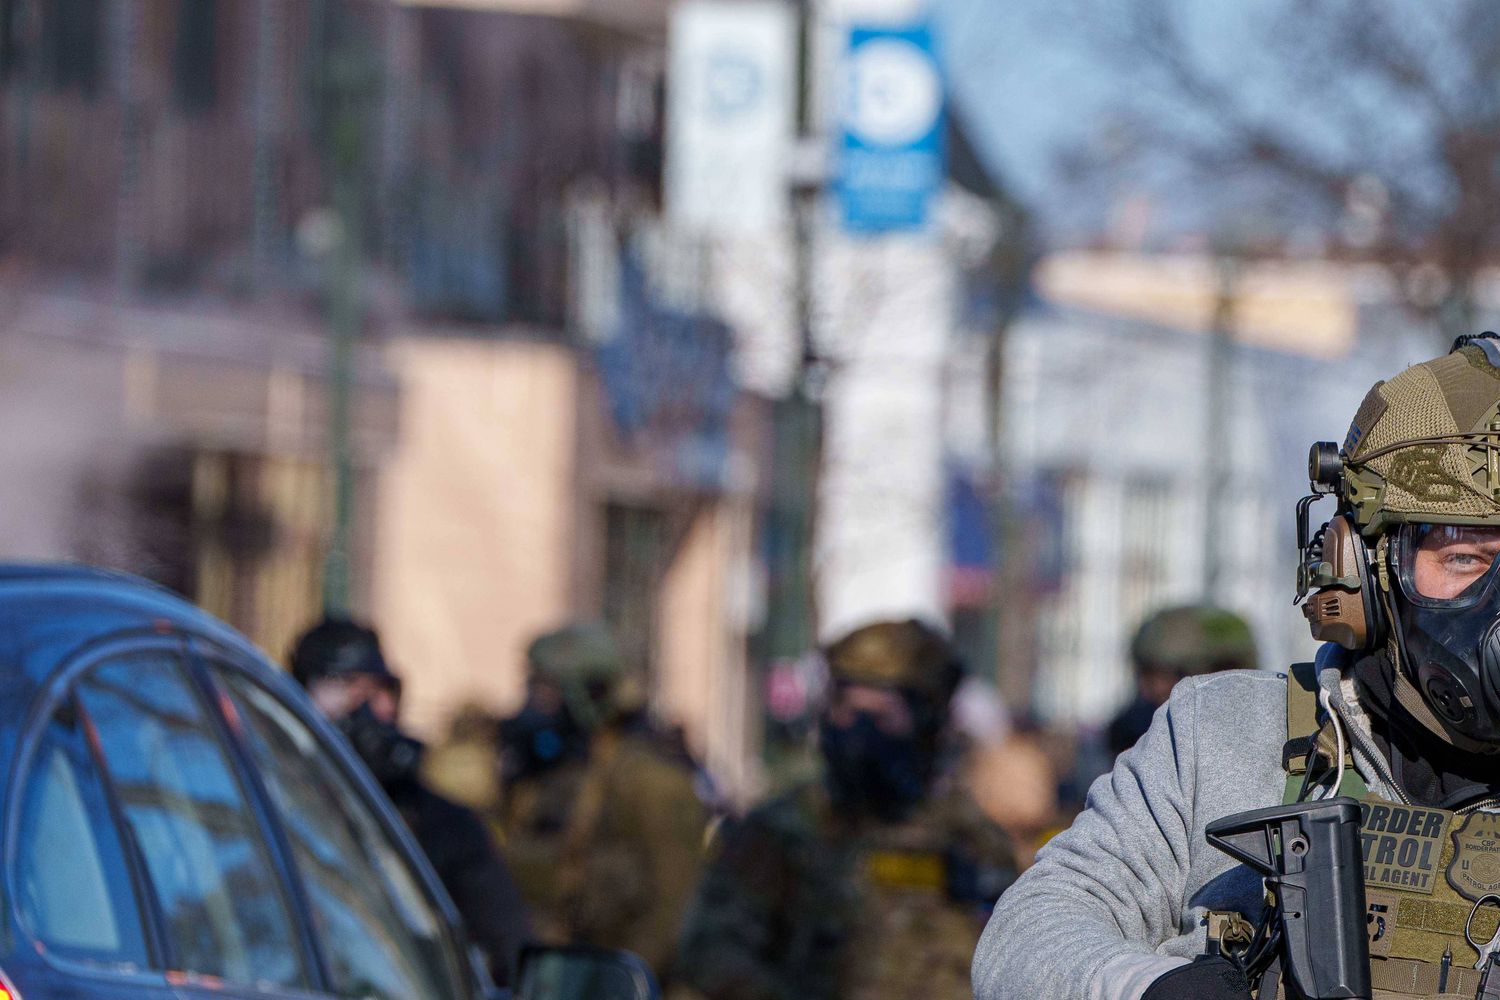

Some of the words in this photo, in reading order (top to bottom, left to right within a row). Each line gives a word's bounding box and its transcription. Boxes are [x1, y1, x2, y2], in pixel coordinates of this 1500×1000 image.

[1360, 803, 1445, 838] ORDER
[1361, 832, 1433, 870] TROL
[1381, 867, 1430, 888] AGENT
